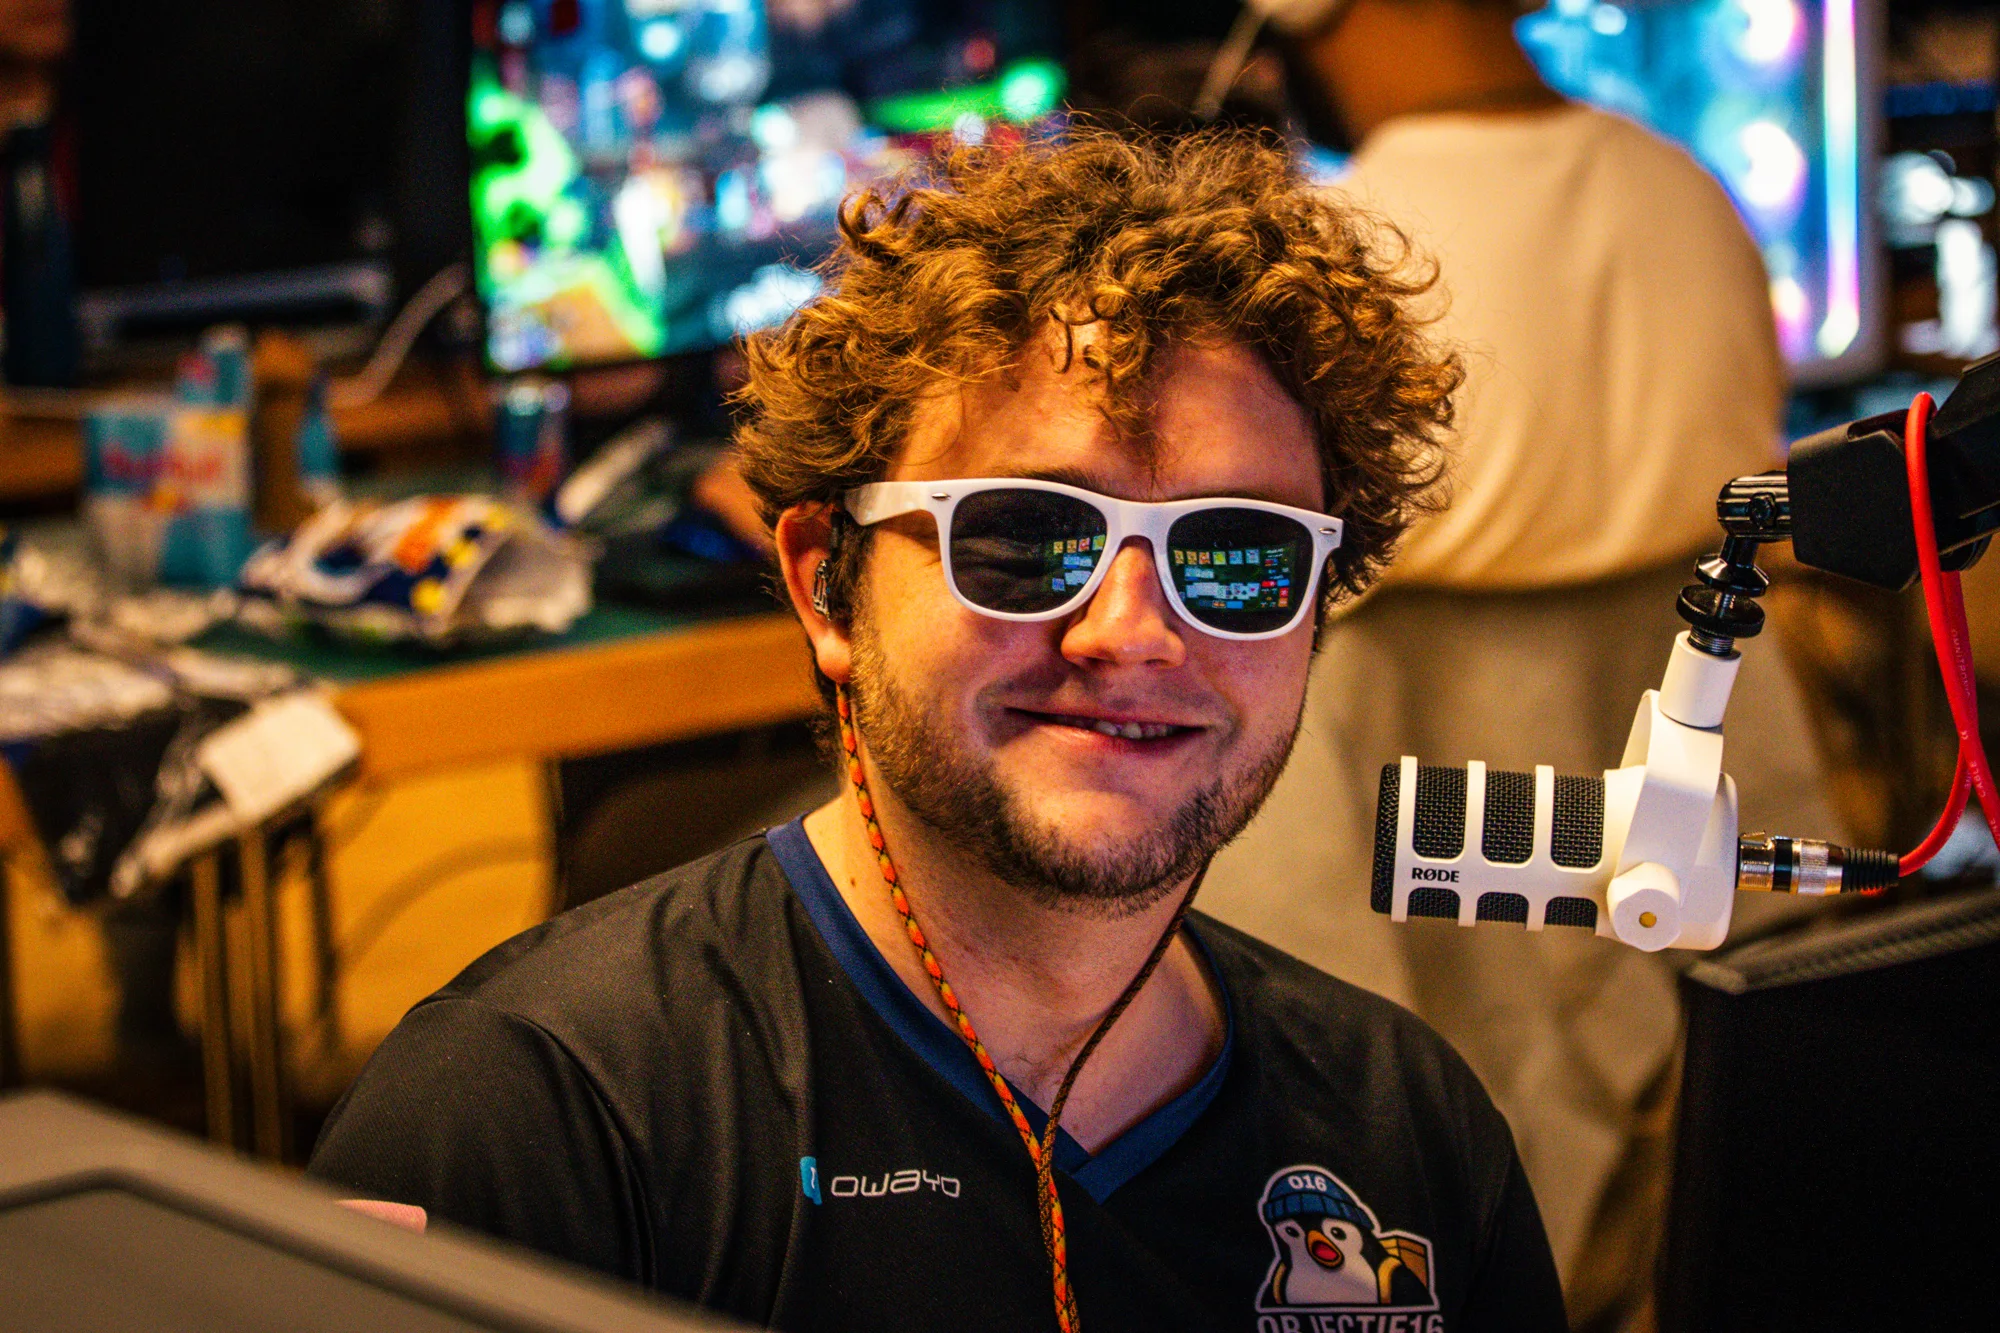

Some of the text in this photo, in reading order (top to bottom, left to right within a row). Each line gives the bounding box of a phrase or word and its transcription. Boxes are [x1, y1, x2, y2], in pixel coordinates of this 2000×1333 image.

[1970, 760, 1986, 798] CABLE
[1411, 867, 1460, 883] RØDE
[831, 1169, 960, 1198] owayo
[1287, 1174, 1328, 1192] 016
